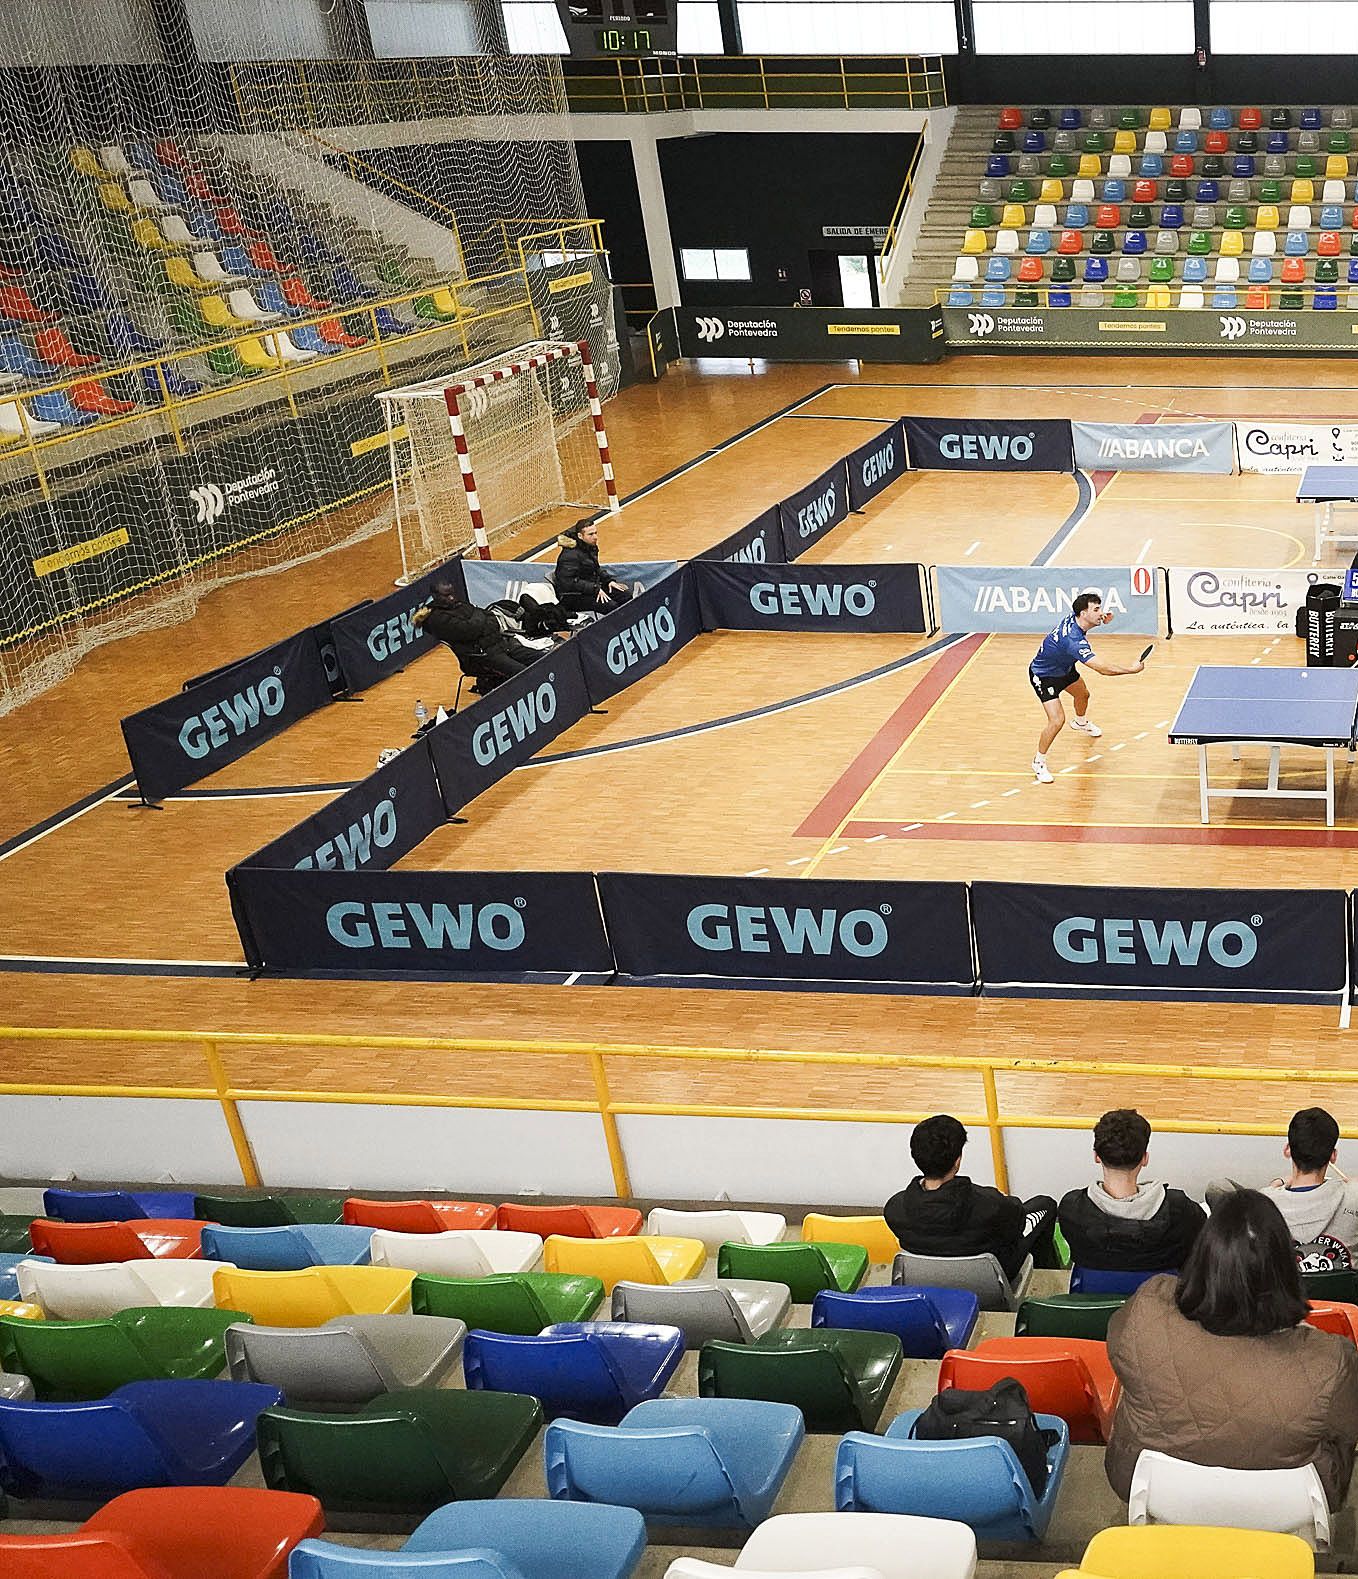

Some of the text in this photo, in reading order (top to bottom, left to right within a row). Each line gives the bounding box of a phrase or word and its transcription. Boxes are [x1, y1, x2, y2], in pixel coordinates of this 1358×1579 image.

[603, 30, 650, 50] 10:17
[826, 227, 851, 235] SALIDA
[727, 319, 777, 331] Deputación
[997, 316, 1044, 326] Deputación
[1249, 319, 1297, 328] Deputación
[728, 329, 778, 337] Pontevedra
[998, 324, 1044, 333] Pontevedra
[1249, 327, 1297, 336] Pontevedra
[1134, 567, 1150, 594] 0
[1187, 571, 1288, 613] Capri
[1308, 610, 1320, 658] BUTTERFLY
